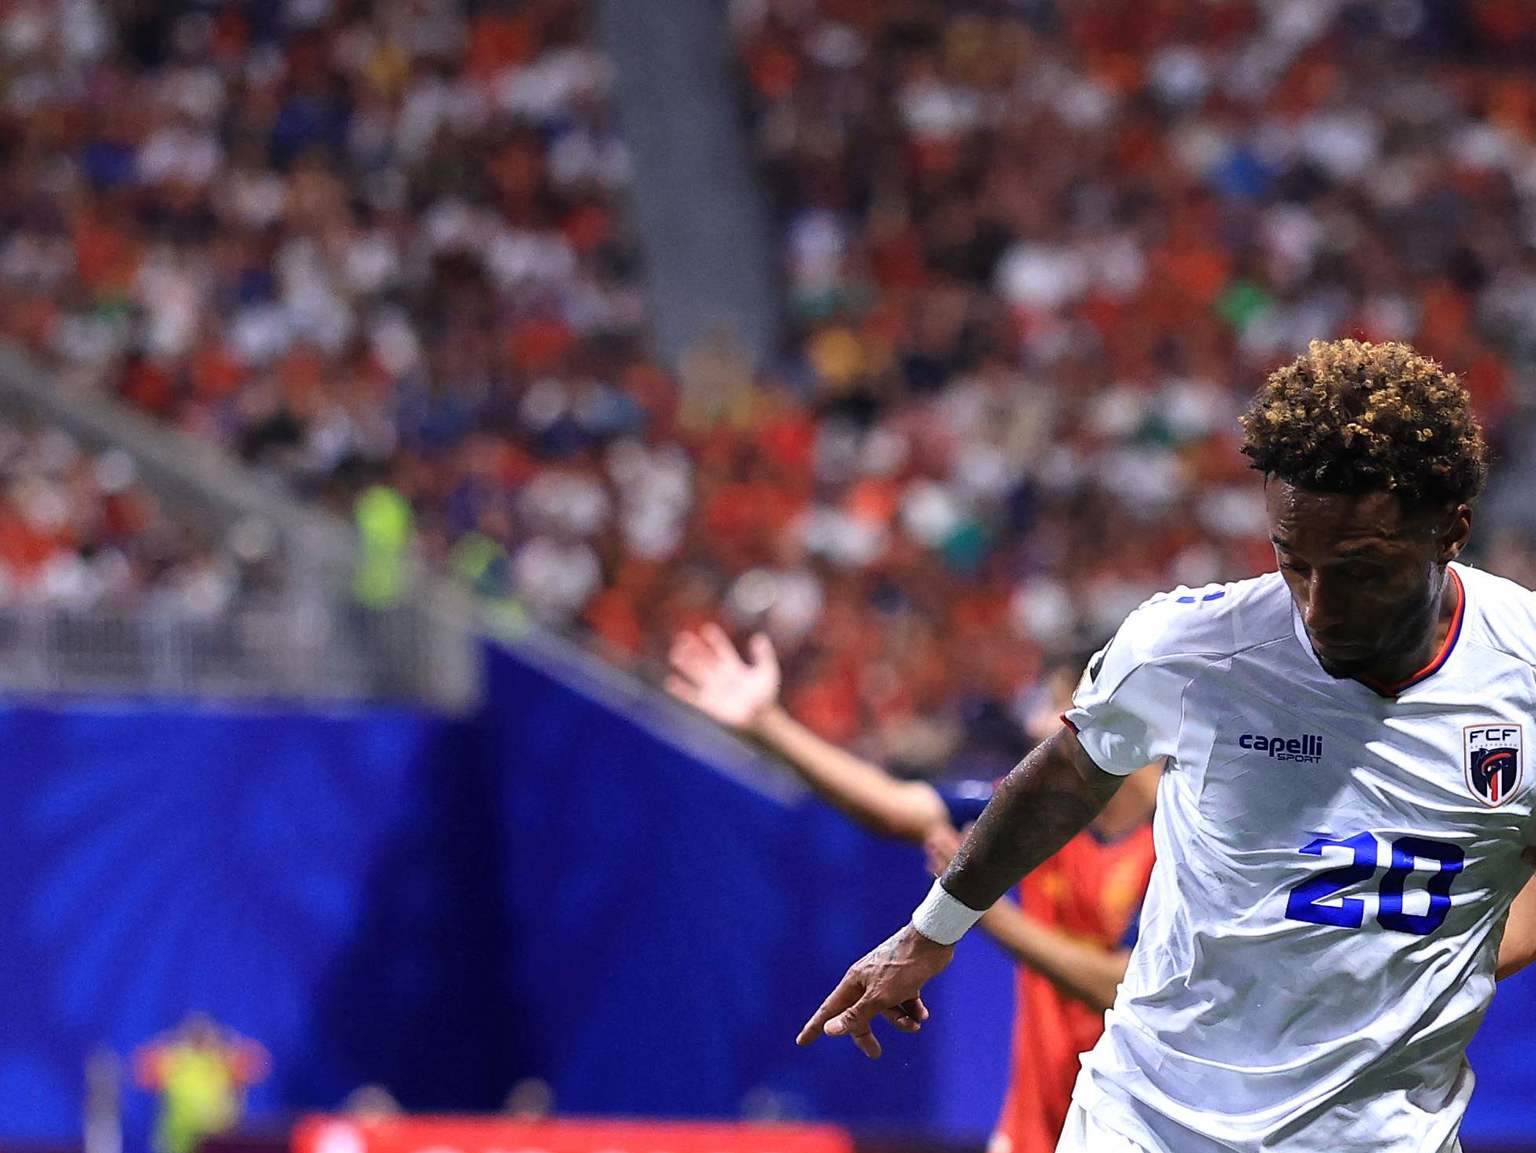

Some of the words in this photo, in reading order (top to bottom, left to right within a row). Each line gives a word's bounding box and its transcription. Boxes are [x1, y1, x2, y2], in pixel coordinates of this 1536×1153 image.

[1470, 728, 1518, 743] FCF
[1239, 734, 1323, 757] capelli
[1277, 753, 1322, 764] SPORT
[1285, 831, 1466, 936] 20
